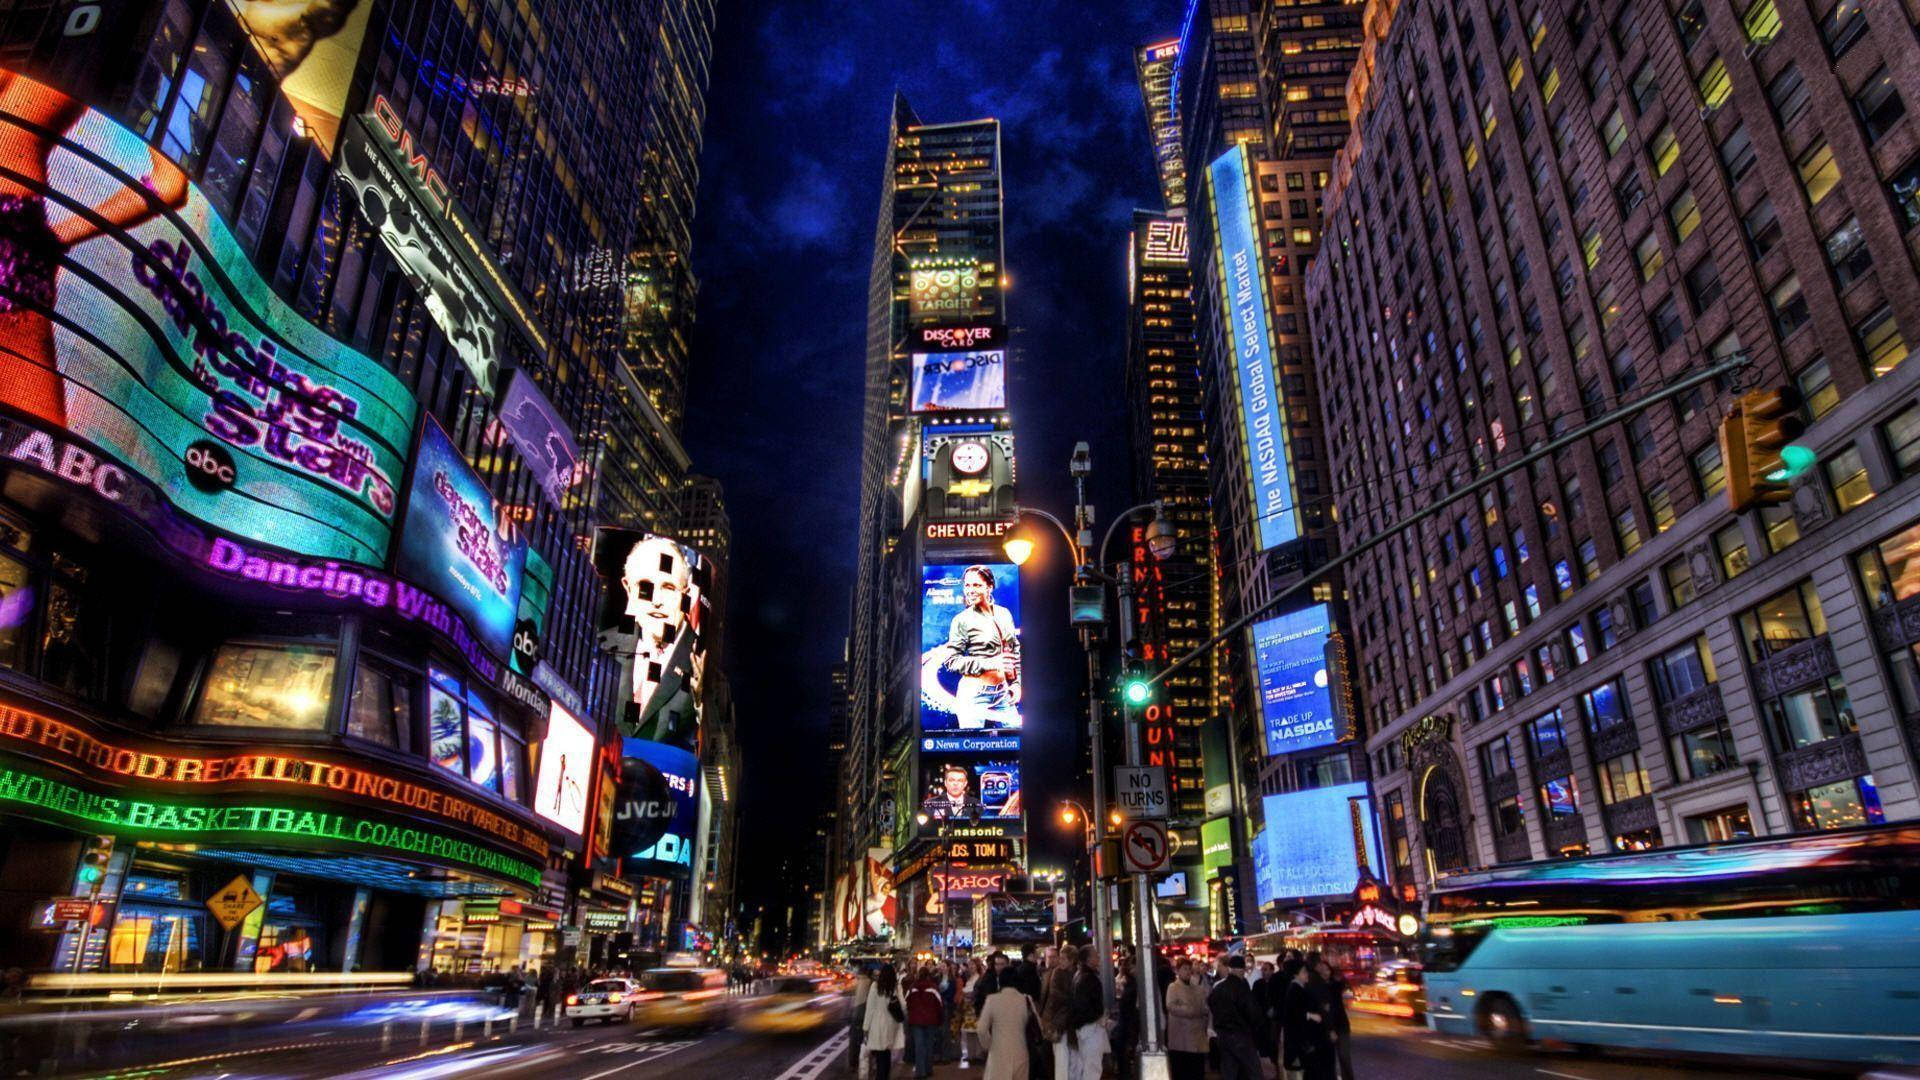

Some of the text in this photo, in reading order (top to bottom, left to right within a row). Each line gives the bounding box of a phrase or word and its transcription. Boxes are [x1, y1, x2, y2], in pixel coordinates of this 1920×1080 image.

[374, 94, 448, 211] GMC
[364, 142, 378, 165] THE
[377, 159, 392, 183] NEW
[391, 179, 407, 203] 2007
[408, 201, 451, 264] YUKON
[918, 298, 973, 311] TARGET
[133, 239, 357, 440] dancing
[923, 327, 992, 341] DISCOVER
[941, 340, 974, 348] CARD
[1232, 248, 1283, 523] The NASDAQ Global Select Market
[203, 389, 396, 517] Stars
[337, 433, 375, 464] with
[9, 430, 127, 500] ABC
[186, 447, 236, 483] abc
[927, 522, 1013, 538] CHEVROLET
[209, 537, 391, 607] Dancing
[396, 580, 450, 634] With
[1301, 711, 1313, 722] UP
[936, 739, 1018, 751] News Corporation
[175, 755, 296, 782] RECALL
[303, 760, 348, 789] TO
[353, 769, 442, 813] INCLUDE
[442, 795, 472, 822] DRY
[984, 780, 1008, 791] 80
[1129, 774, 1152, 789] NO
[617, 801, 660, 819] JVC
[1120, 790, 1165, 807] TURNS
[129, 802, 349, 840] BASKETBALL
[355, 820, 428, 853] COACH
[431, 835, 478, 865] POKEY
[974, 843, 996, 856] TOM
